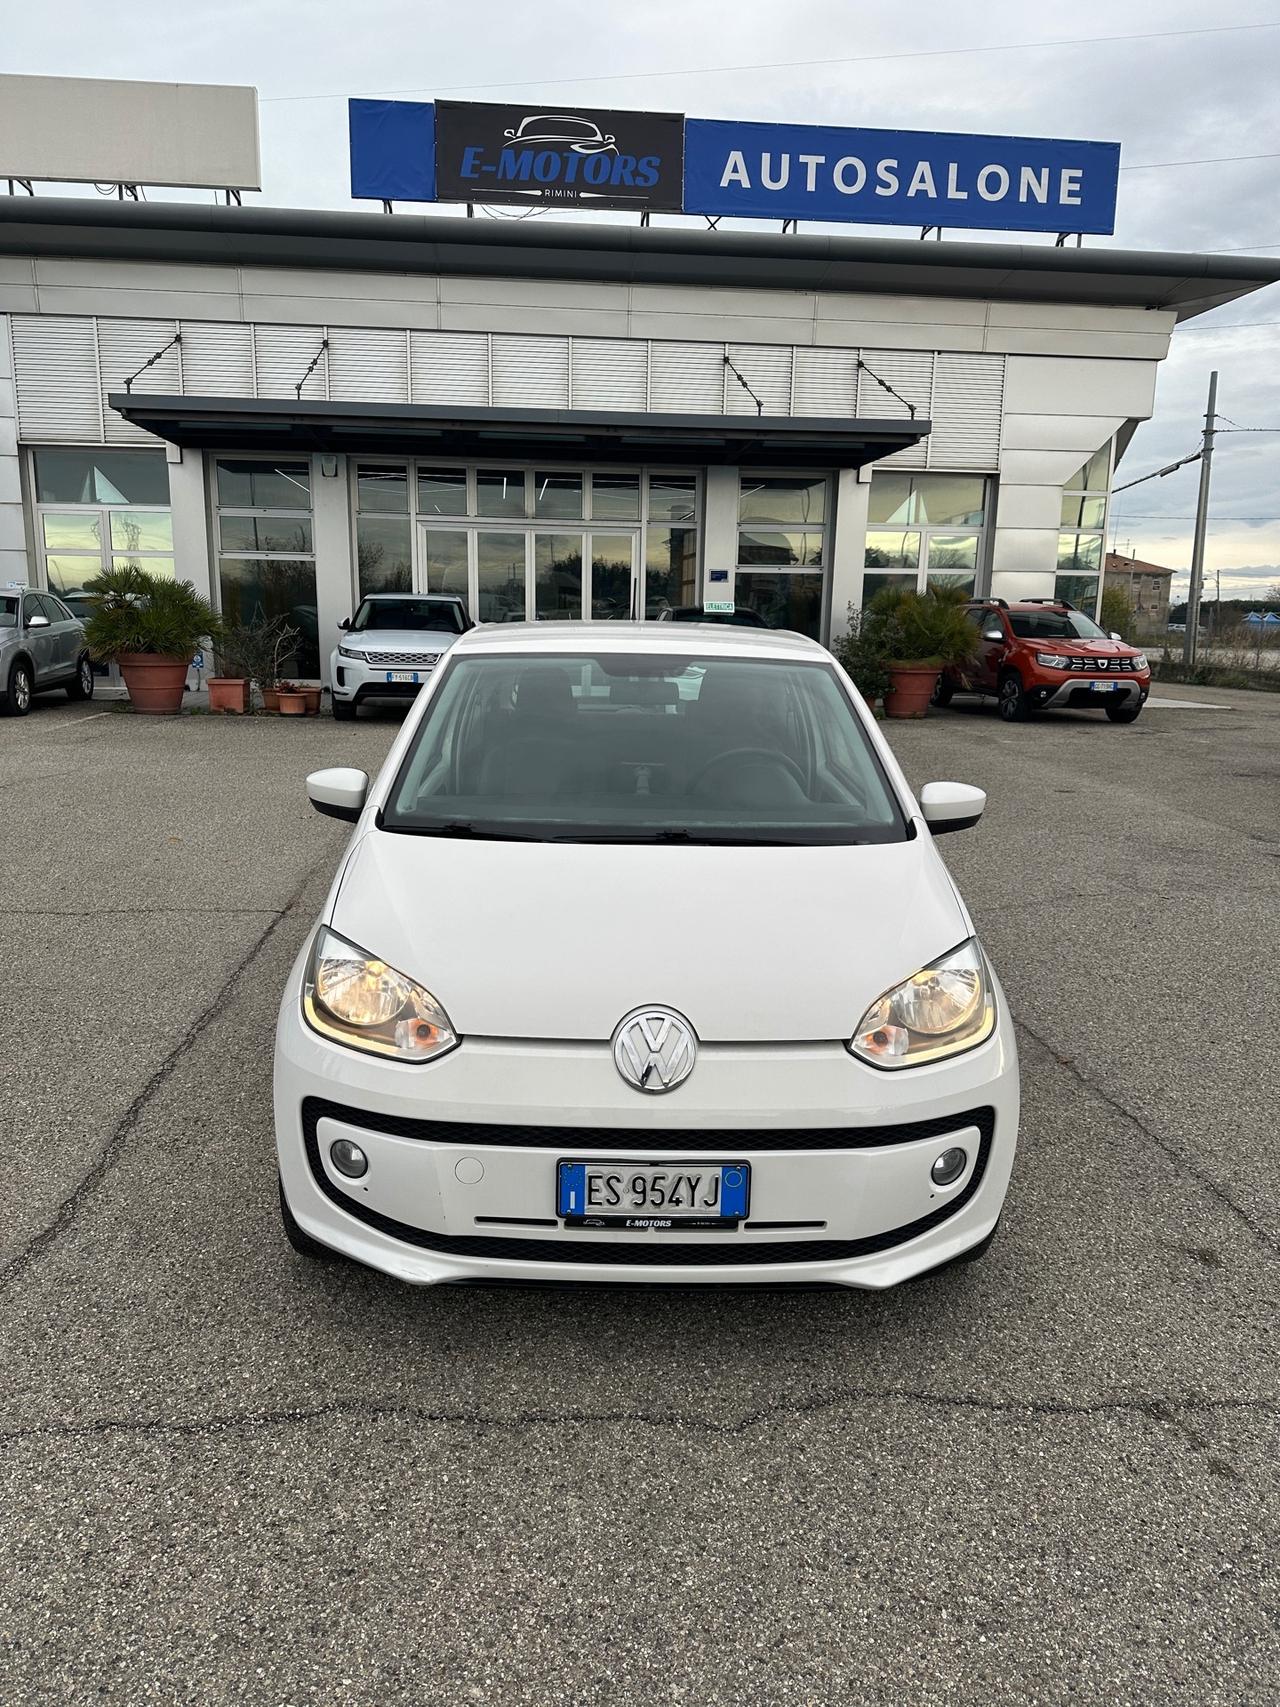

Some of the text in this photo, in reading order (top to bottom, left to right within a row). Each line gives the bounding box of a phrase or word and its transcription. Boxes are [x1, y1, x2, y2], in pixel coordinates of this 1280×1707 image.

[459, 146, 661, 187] E-MOTORS
[719, 150, 1084, 206] AUTOSALONE
[544, 188, 578, 199] RIMINI
[587, 1174, 720, 1208] ES 954YJ
[626, 1219, 672, 1227] E-MOTORS
